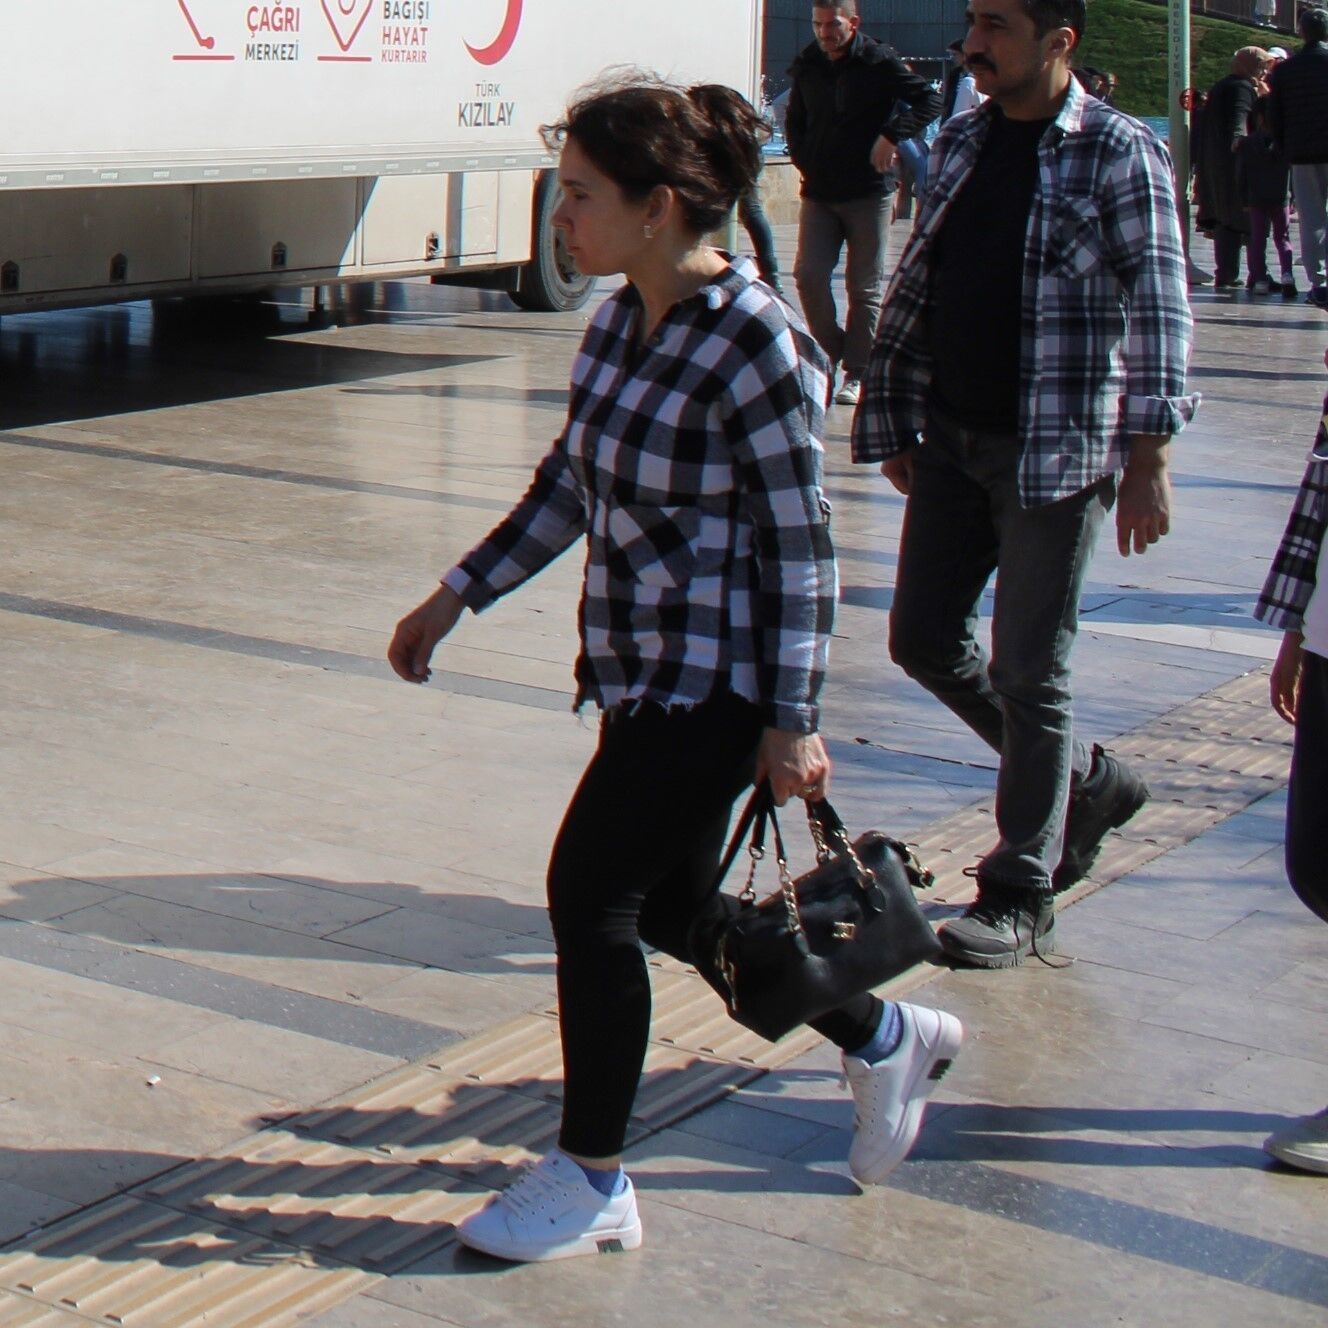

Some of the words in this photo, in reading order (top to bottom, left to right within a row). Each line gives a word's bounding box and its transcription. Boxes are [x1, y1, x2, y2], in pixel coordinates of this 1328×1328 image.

[246, 0, 300, 38] ÇAĞRI
[381, 26, 428, 47] HAYAT
[245, 39, 299, 62] MERKEZİ
[380, 49, 427, 64] KURTARIR
[475, 79, 501, 98] TÜRK
[457, 102, 515, 128] KIZILAY
